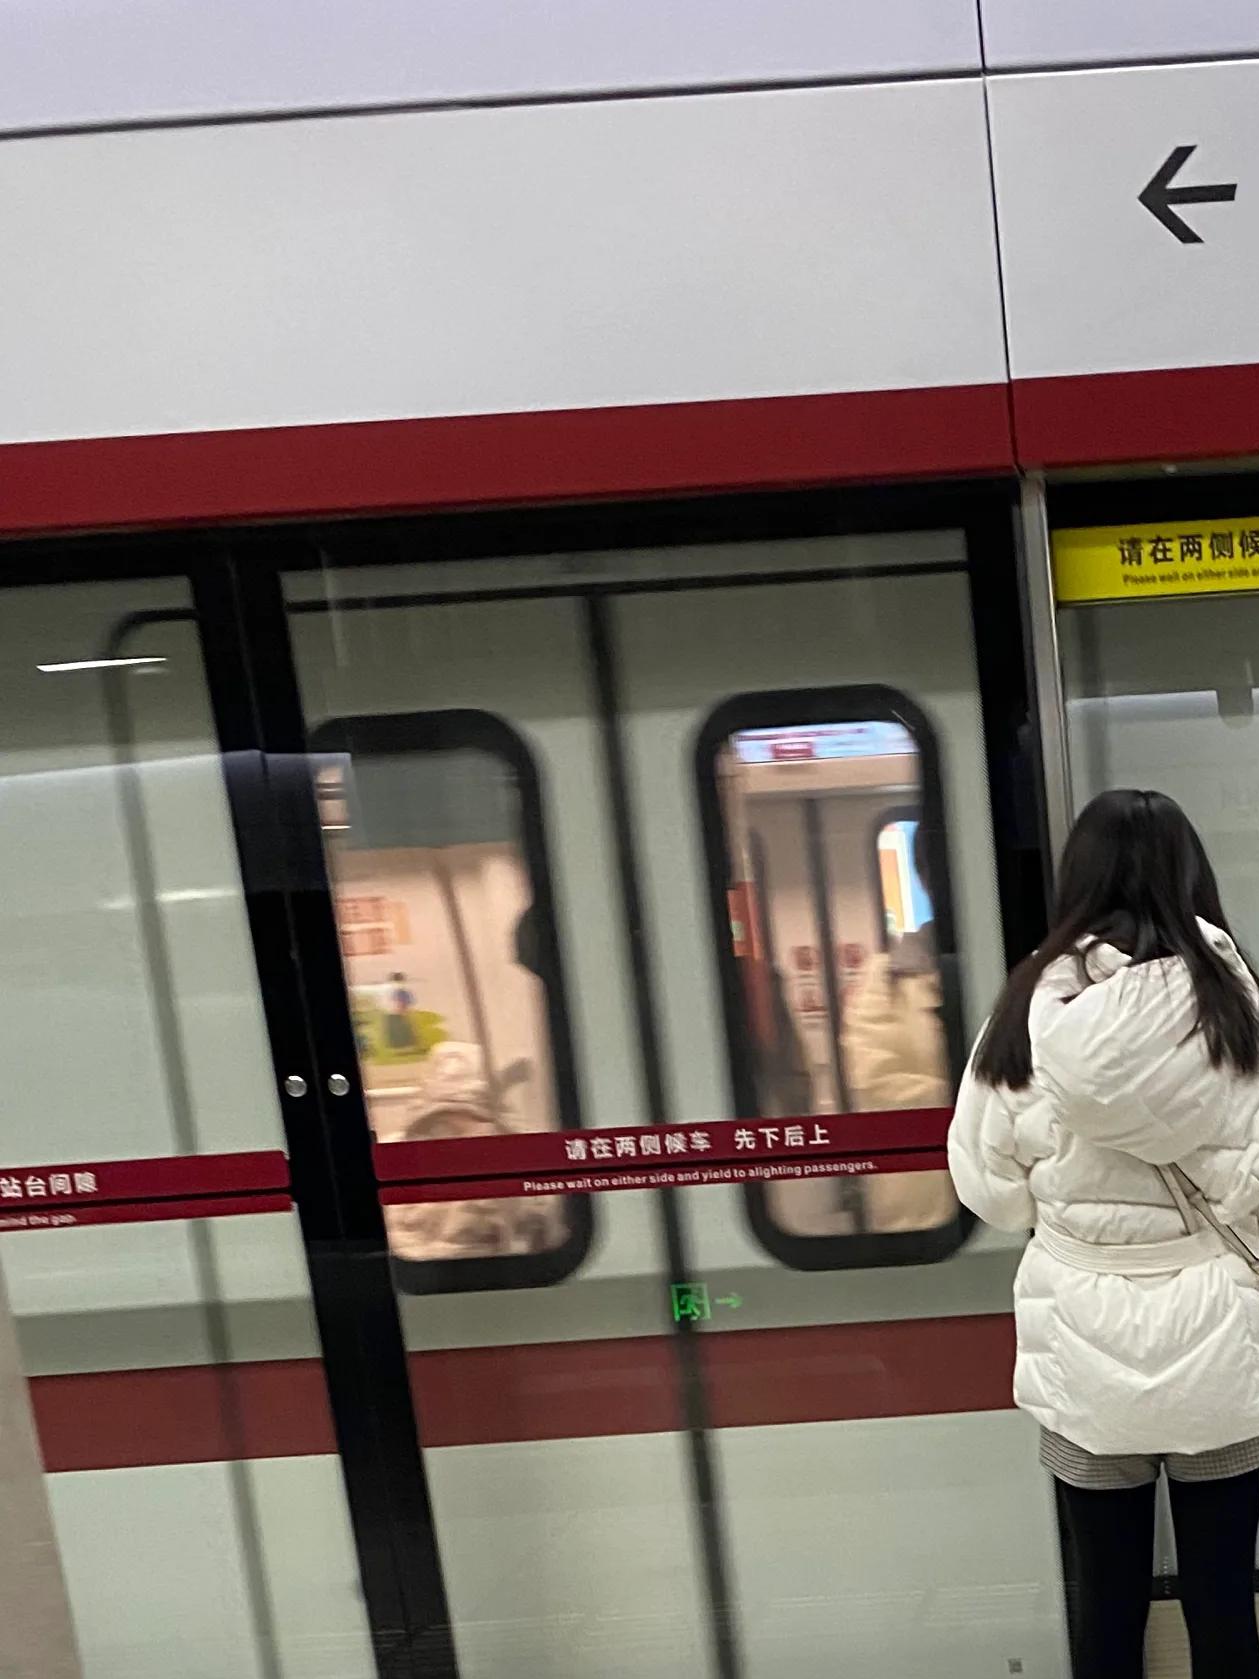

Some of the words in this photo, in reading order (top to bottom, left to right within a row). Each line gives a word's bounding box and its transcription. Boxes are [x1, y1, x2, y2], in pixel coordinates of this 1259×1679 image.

[565, 1130, 711, 1160] 请在两侧候车
[734, 1124, 830, 1150] 先下后上
[0, 1171, 98, 1198] 站台间隙
[523, 1179, 565, 1192] Please
[566, 1177, 592, 1189] wait
[594, 1177, 610, 1188] on
[611, 1174, 647, 1186] either
[649, 1172, 675, 1184] side
[676, 1170, 700, 1182] and
[702, 1166, 732, 1182] yield
[733, 1167, 746, 1178] to
[748, 1163, 802, 1178] alighting
